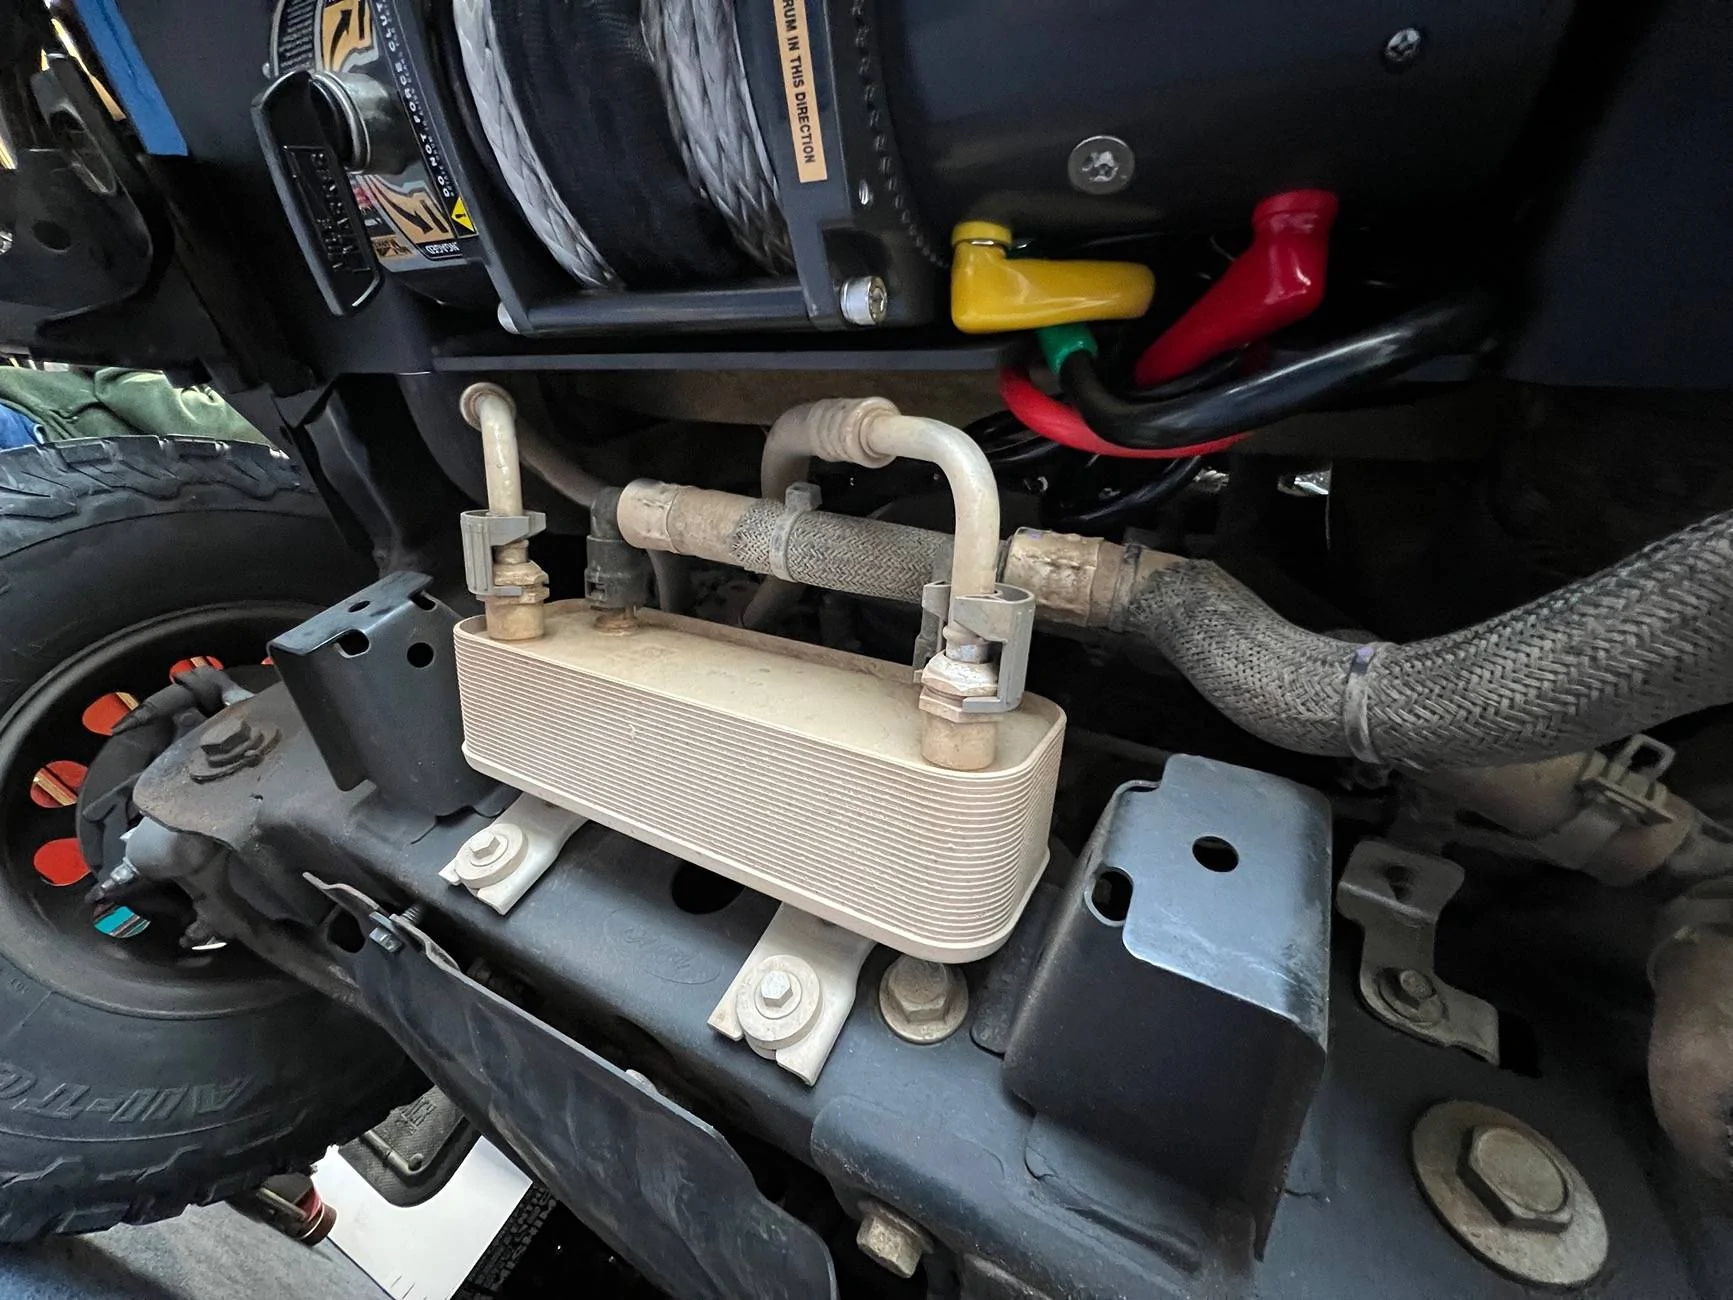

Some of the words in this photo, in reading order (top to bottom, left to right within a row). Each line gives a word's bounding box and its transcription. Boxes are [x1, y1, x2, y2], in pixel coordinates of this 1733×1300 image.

[787, 35, 800, 51] IN
[790, 55, 804, 88] THIS
[394, 61, 421, 123] FORCE
[795, 92, 816, 163] DIRECTION
[420, 132, 438, 167] NOT
[438, 175, 451, 198] DO
[425, 241, 460, 255] NGAGED
